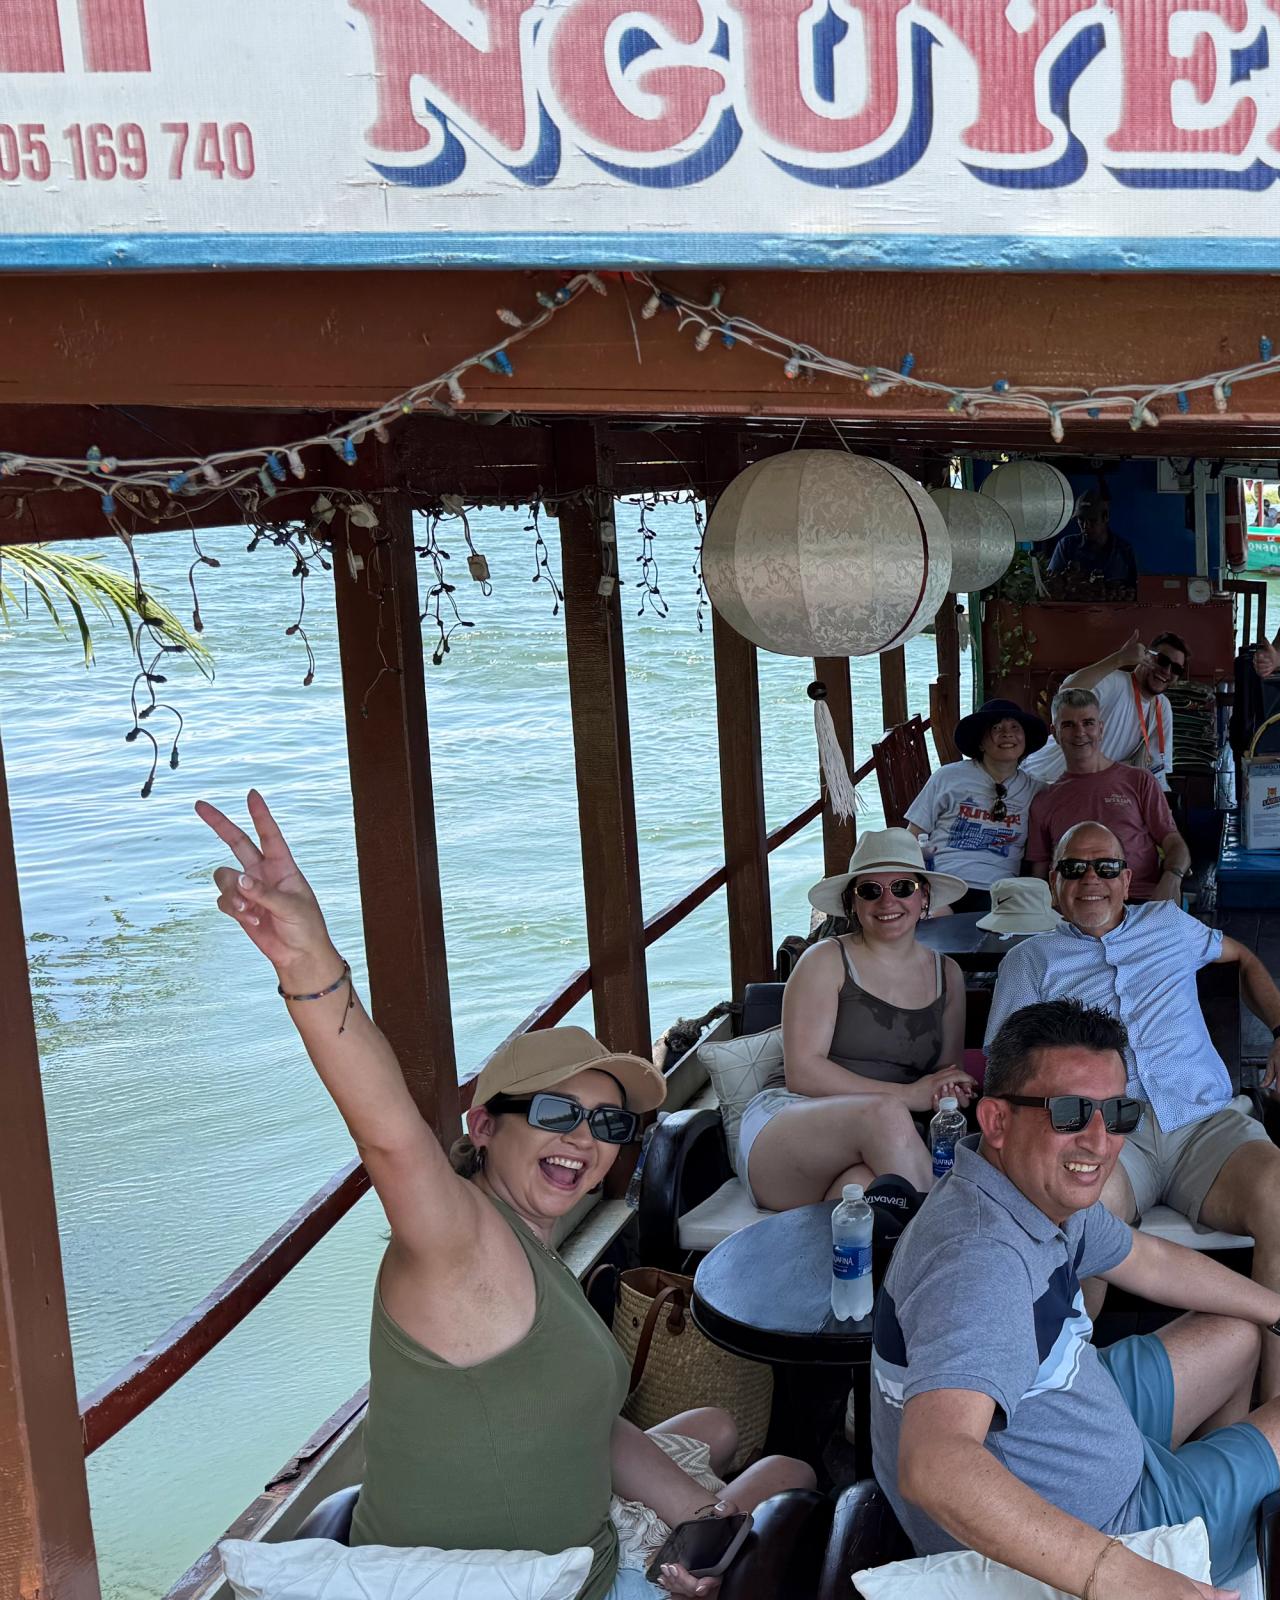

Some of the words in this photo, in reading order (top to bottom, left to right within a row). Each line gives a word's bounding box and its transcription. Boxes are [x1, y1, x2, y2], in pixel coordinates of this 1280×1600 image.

[62, 123, 148, 181] 169
[160, 122, 255, 181] 740
[863, 1195, 909, 1210] TERADATA
